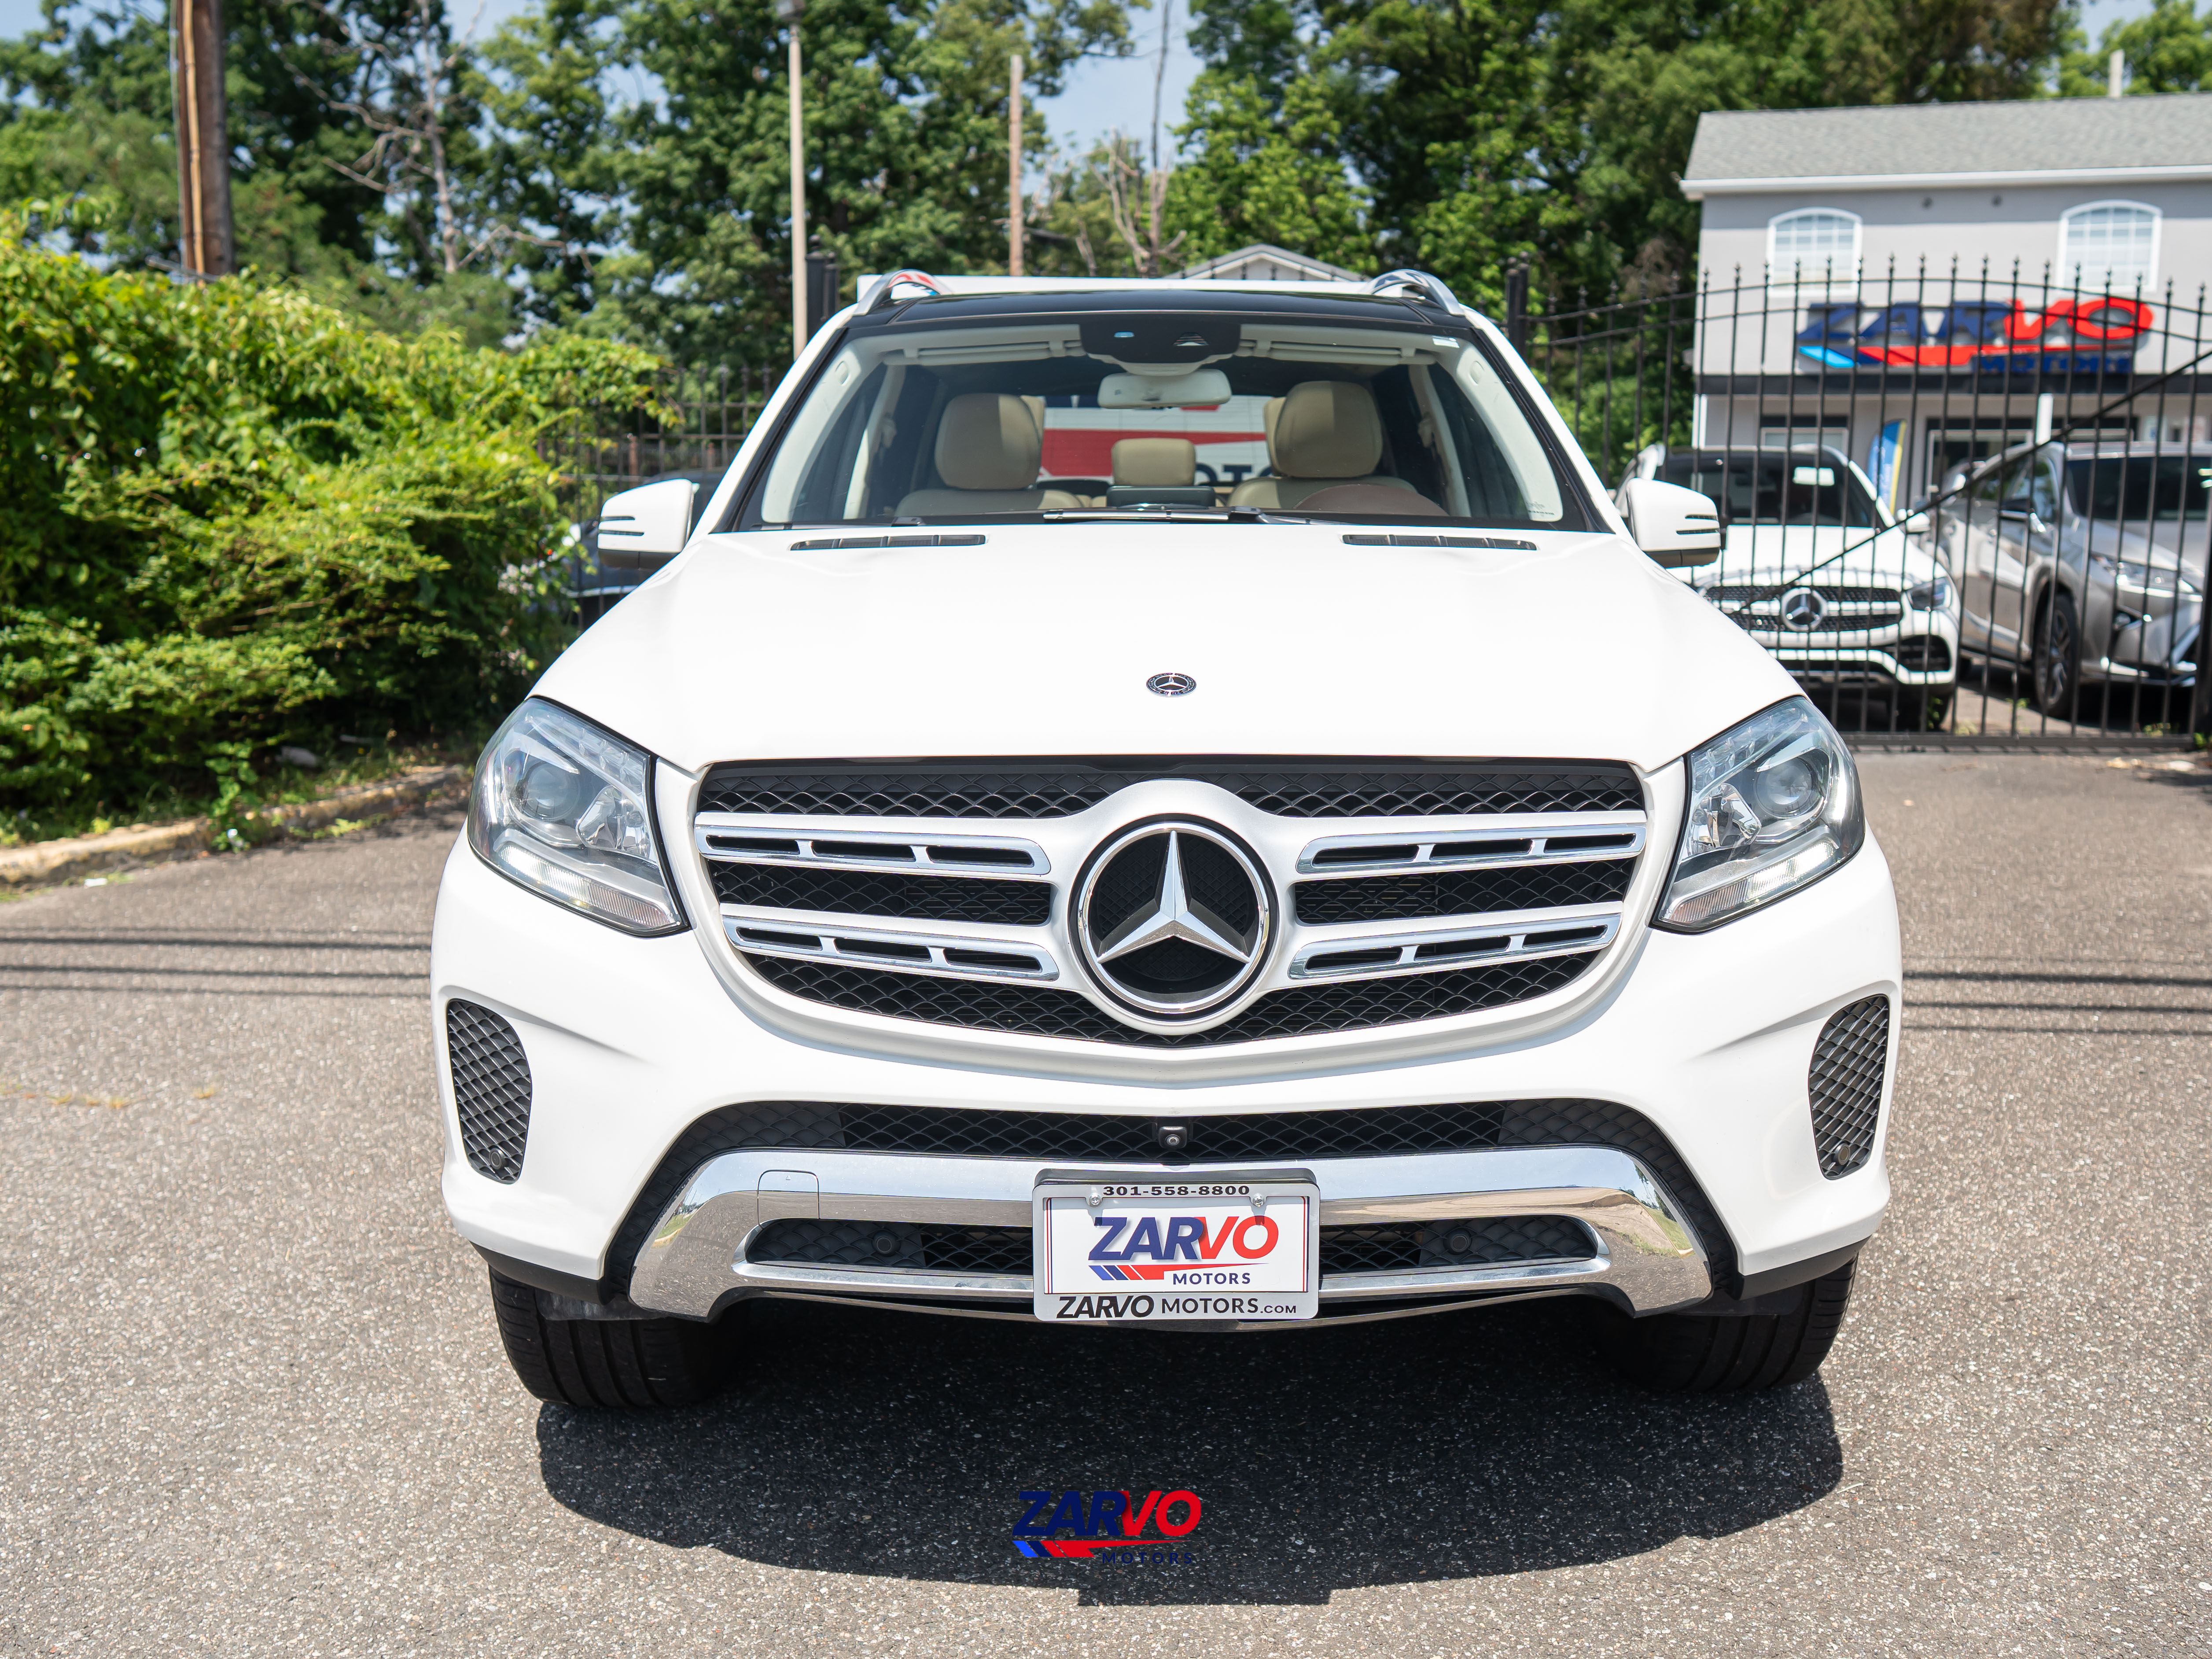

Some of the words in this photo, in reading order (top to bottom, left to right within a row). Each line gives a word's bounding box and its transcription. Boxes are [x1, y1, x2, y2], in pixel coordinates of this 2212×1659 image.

[1797, 296, 2154, 341] ZARVO
[1103, 1185, 1250, 1196] 301-558-8800
[1088, 1215, 1279, 1261] ZARVO
[1173, 1273, 1251, 1285] MOTORS
[1056, 1295, 1154, 1318] ZARVO
